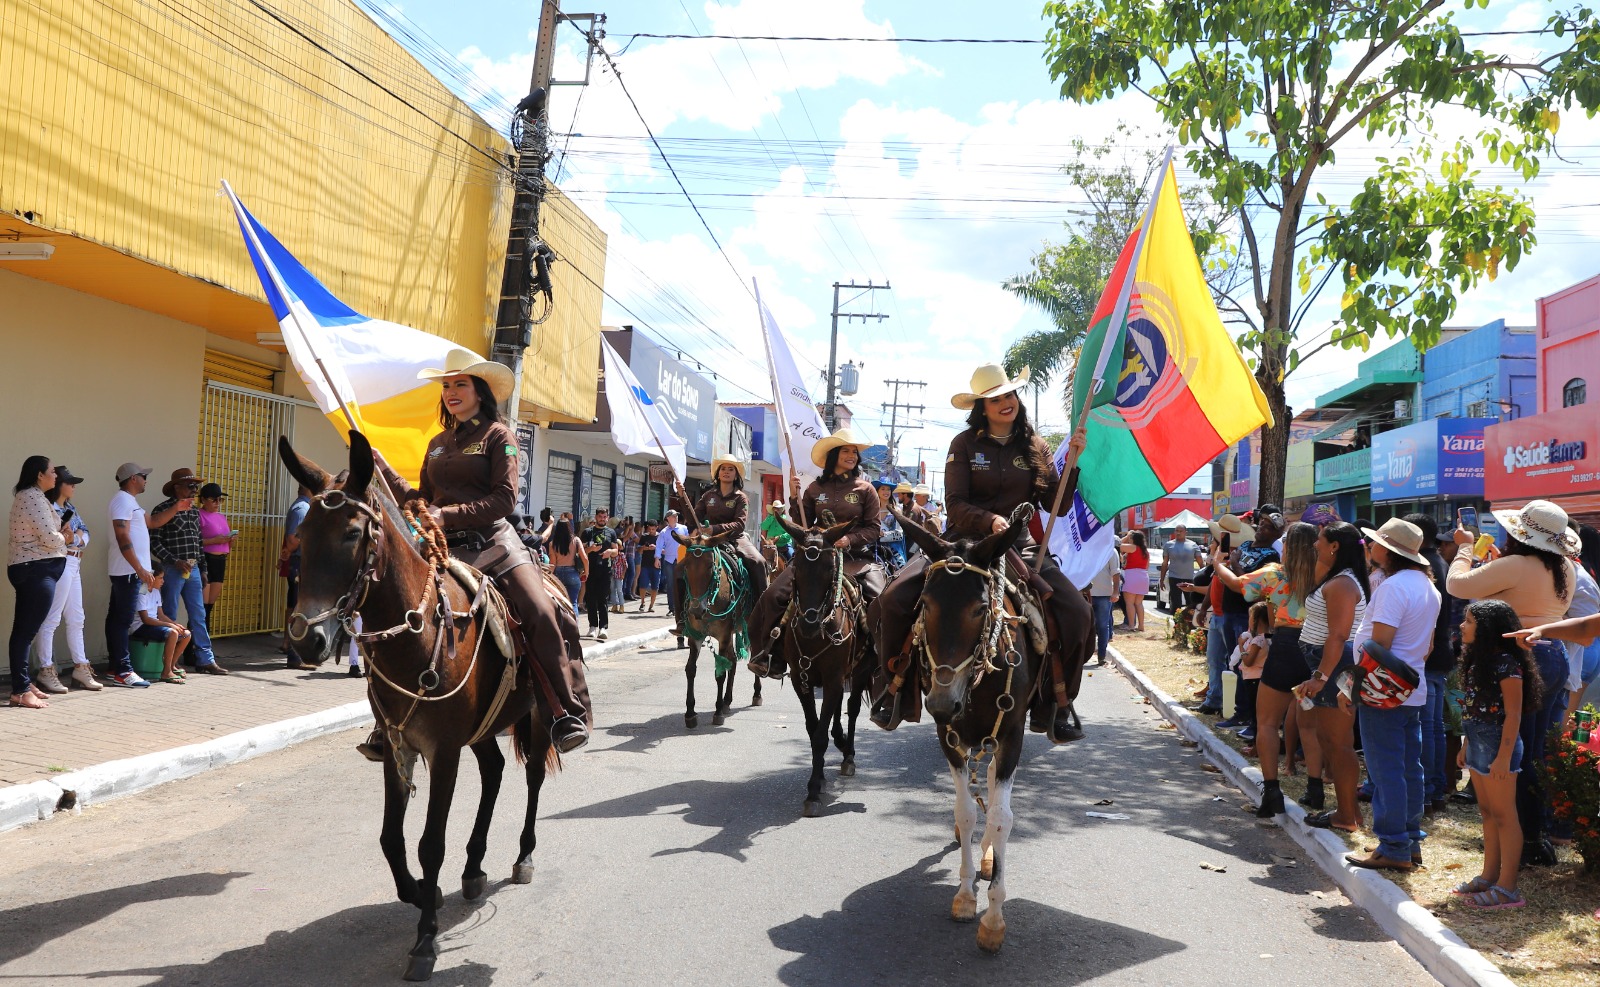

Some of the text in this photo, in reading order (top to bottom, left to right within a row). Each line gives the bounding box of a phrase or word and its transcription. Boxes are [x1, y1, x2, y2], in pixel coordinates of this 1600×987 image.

[658, 360, 699, 411] Lar do Sono
[1442, 435, 1485, 450] Yana
[1388, 451, 1413, 480] Yana
